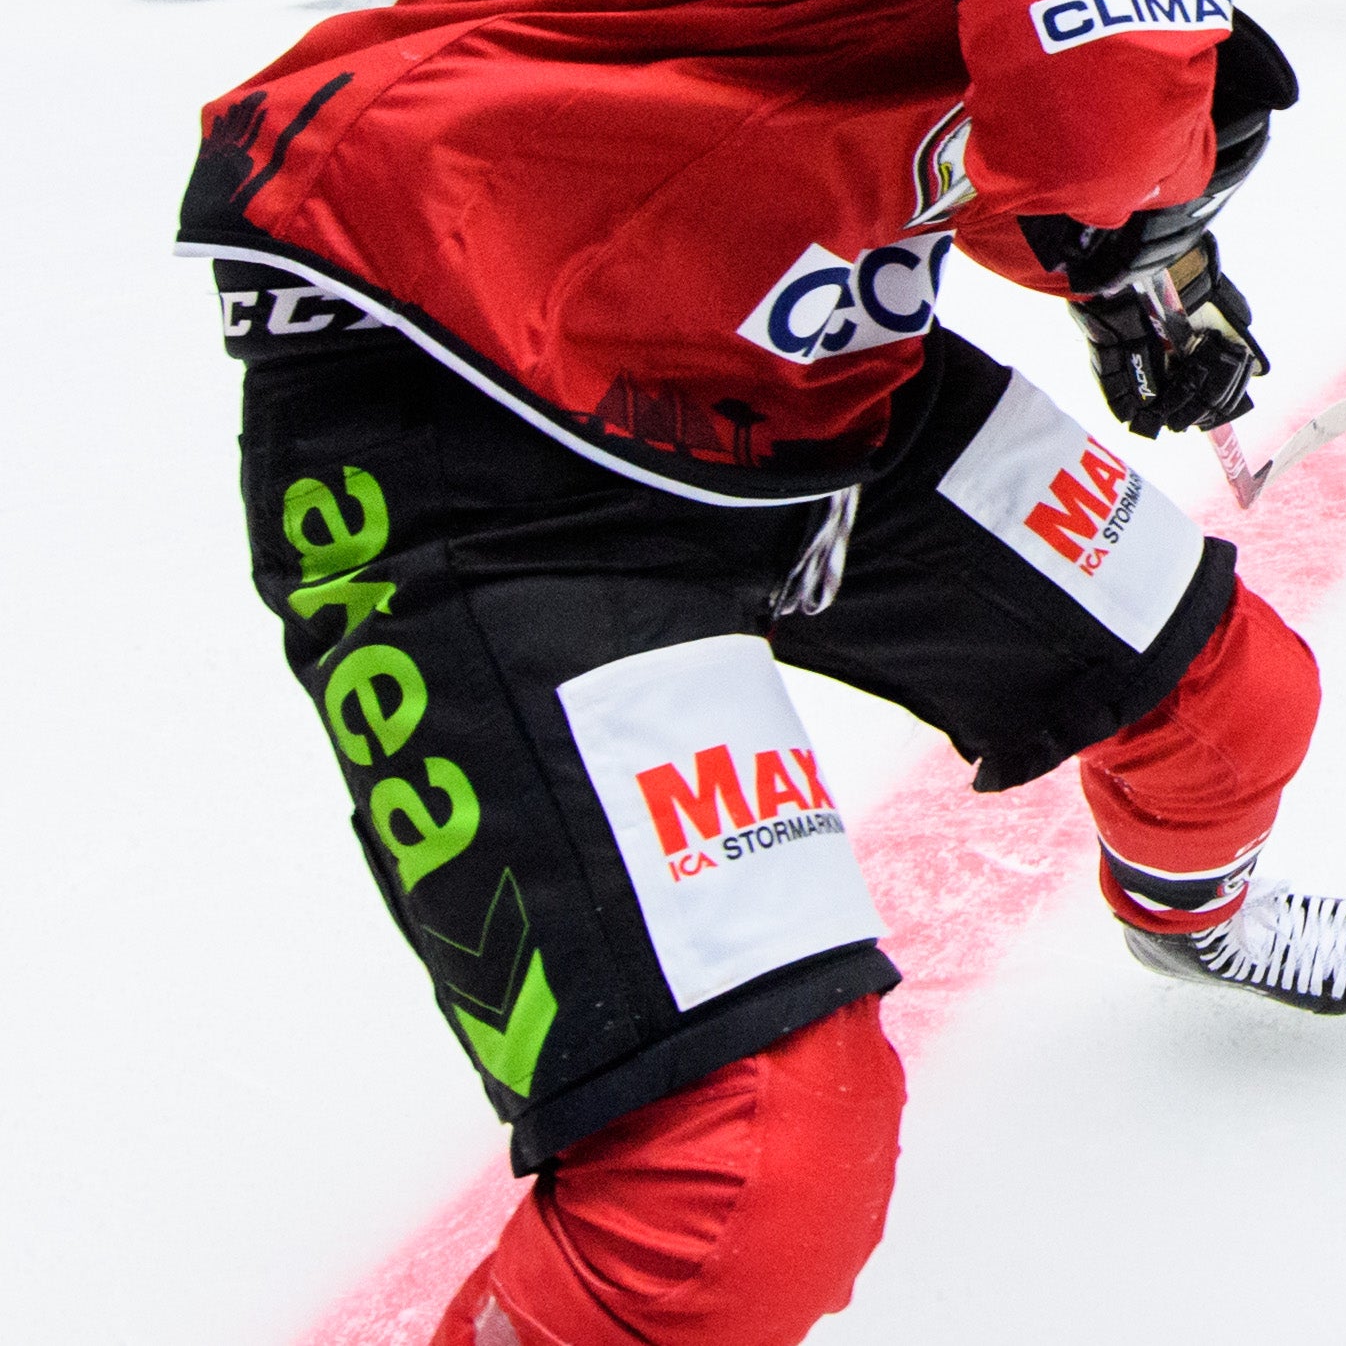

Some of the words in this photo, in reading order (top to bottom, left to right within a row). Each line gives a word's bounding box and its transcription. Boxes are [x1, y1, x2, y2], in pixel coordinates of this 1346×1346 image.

[220, 291, 402, 340] CC
[1079, 548, 1111, 577] ICA
[282, 465, 482, 895] atea
[636, 743, 836, 857] MAX
[668, 852, 719, 883] ICA
